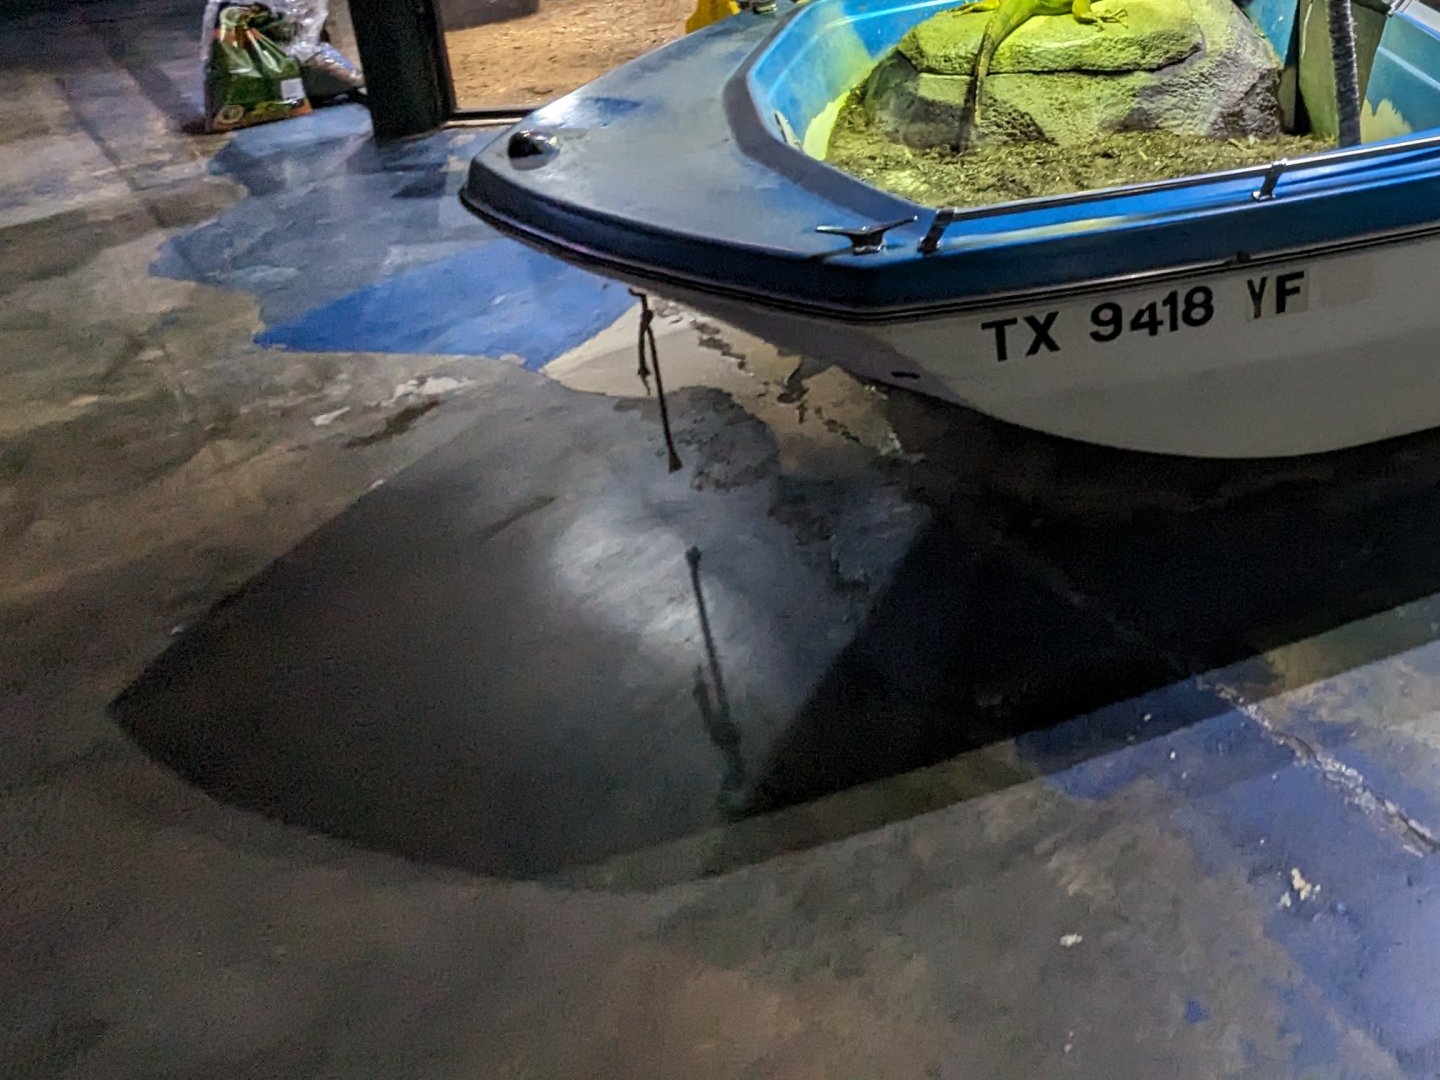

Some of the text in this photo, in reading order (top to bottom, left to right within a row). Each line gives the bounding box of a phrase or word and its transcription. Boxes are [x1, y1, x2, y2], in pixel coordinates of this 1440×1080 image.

[981, 270, 1305, 363] TX 9418 YF
